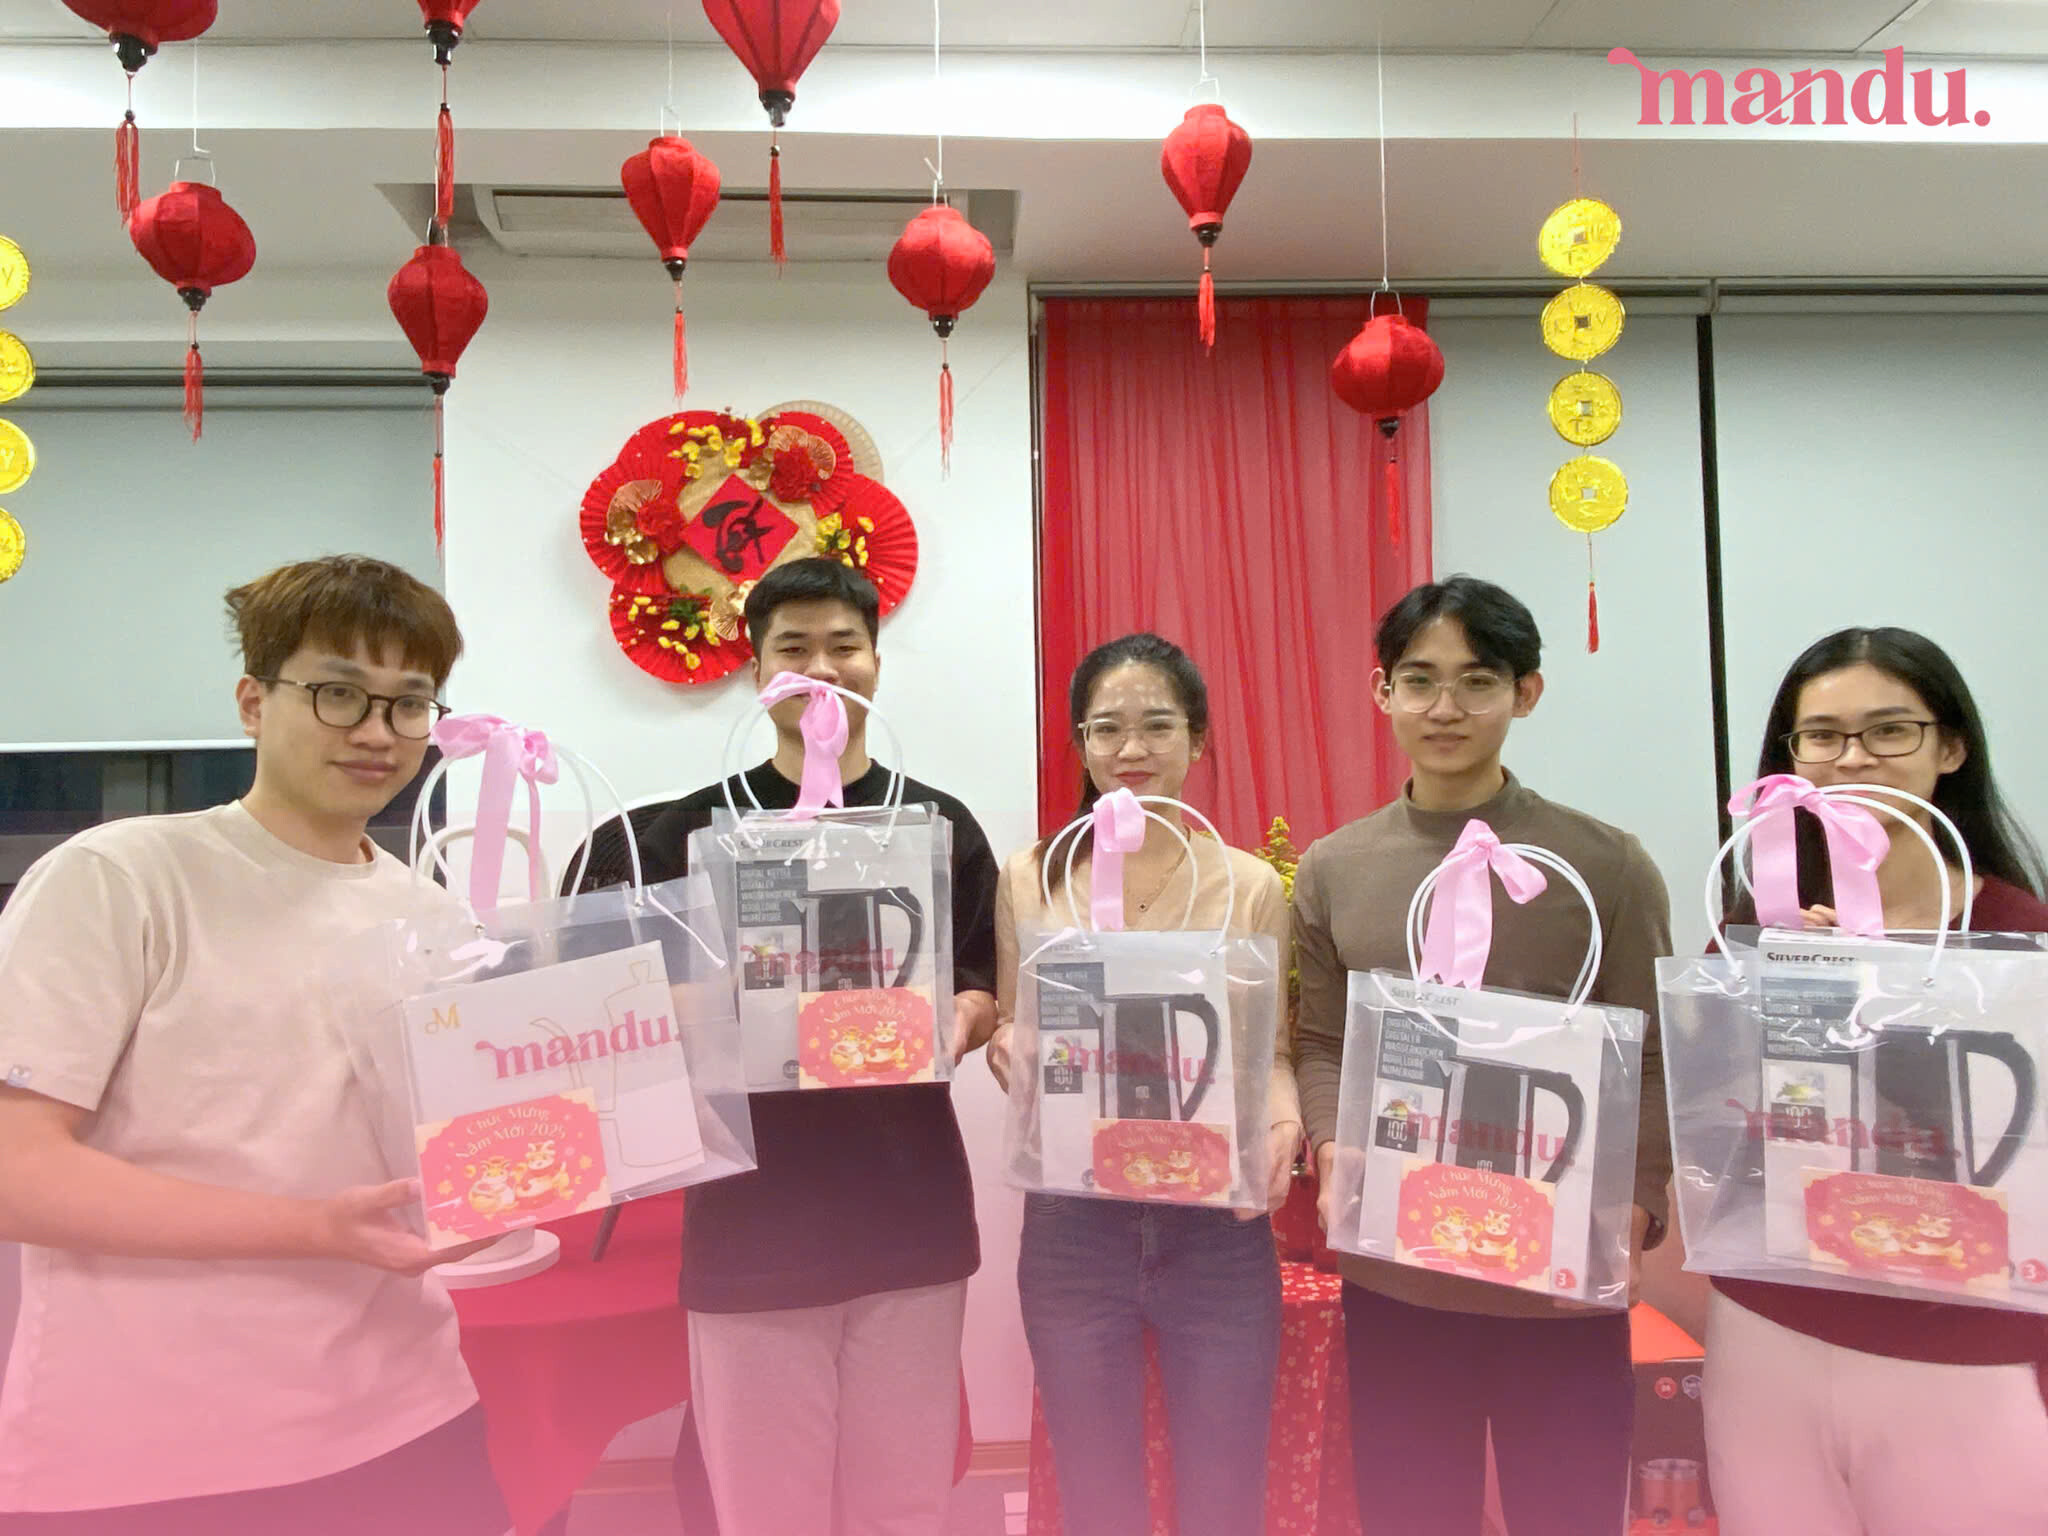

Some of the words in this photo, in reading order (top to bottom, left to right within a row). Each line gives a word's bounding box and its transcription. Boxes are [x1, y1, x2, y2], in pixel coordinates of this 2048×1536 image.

[474, 1008, 681, 1079] mandu.
[1557, 1272, 1569, 1286] 3
[2025, 1264, 2037, 1280] 3
